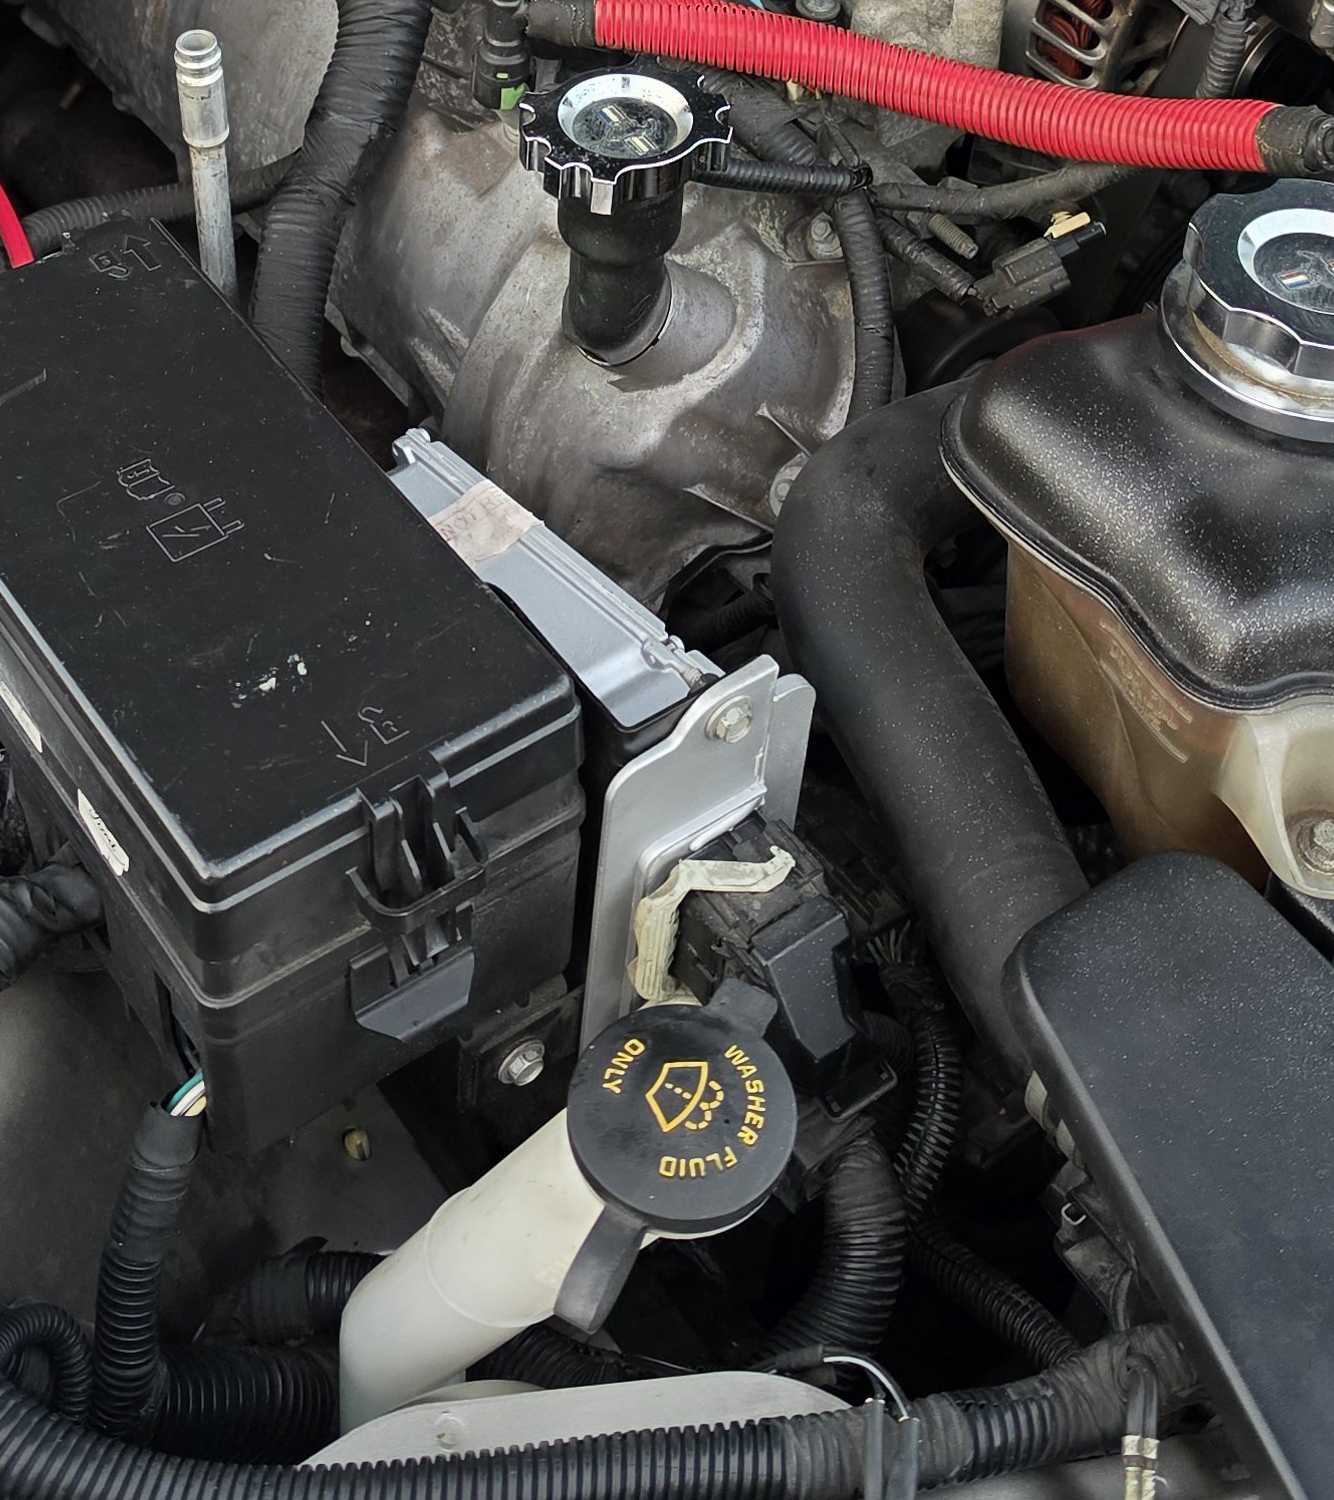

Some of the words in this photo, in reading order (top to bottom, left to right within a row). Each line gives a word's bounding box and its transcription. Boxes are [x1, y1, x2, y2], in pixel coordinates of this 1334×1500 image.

[602, 1038, 646, 1094] ONLY
[723, 1044, 767, 1147] WASHER
[659, 1146, 739, 1179] FLUID
